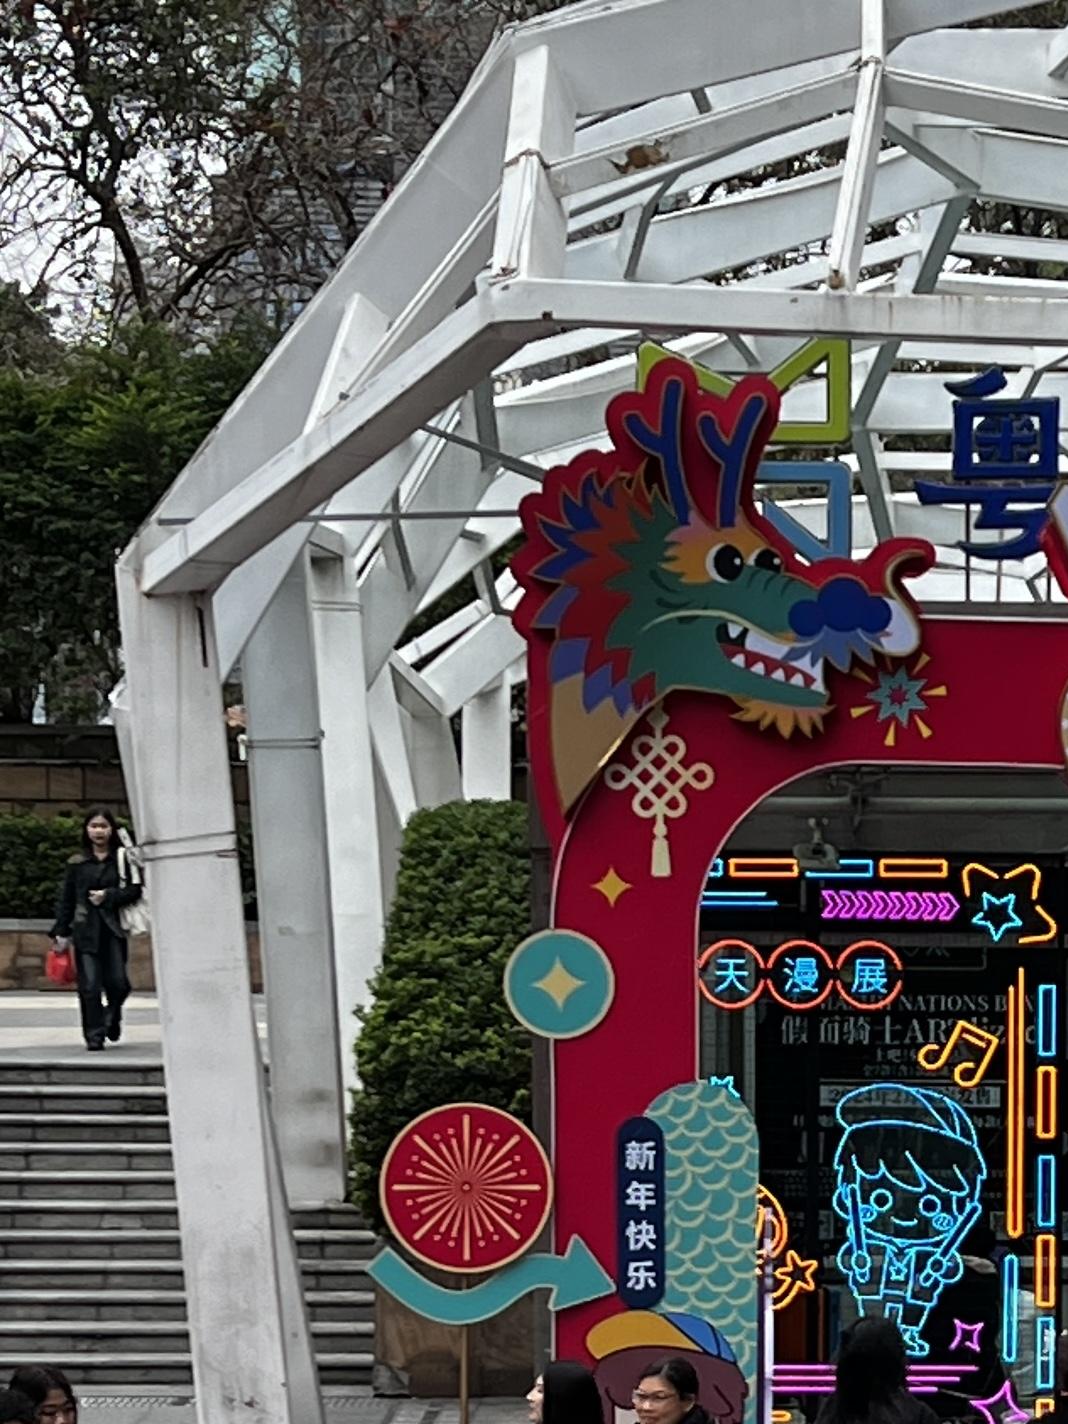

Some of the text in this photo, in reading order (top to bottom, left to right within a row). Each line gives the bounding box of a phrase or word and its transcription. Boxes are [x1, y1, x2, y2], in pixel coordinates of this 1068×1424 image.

[898, 995, 990, 1013] NATIONS
[624, 1140, 657, 1290] 新年快乐
